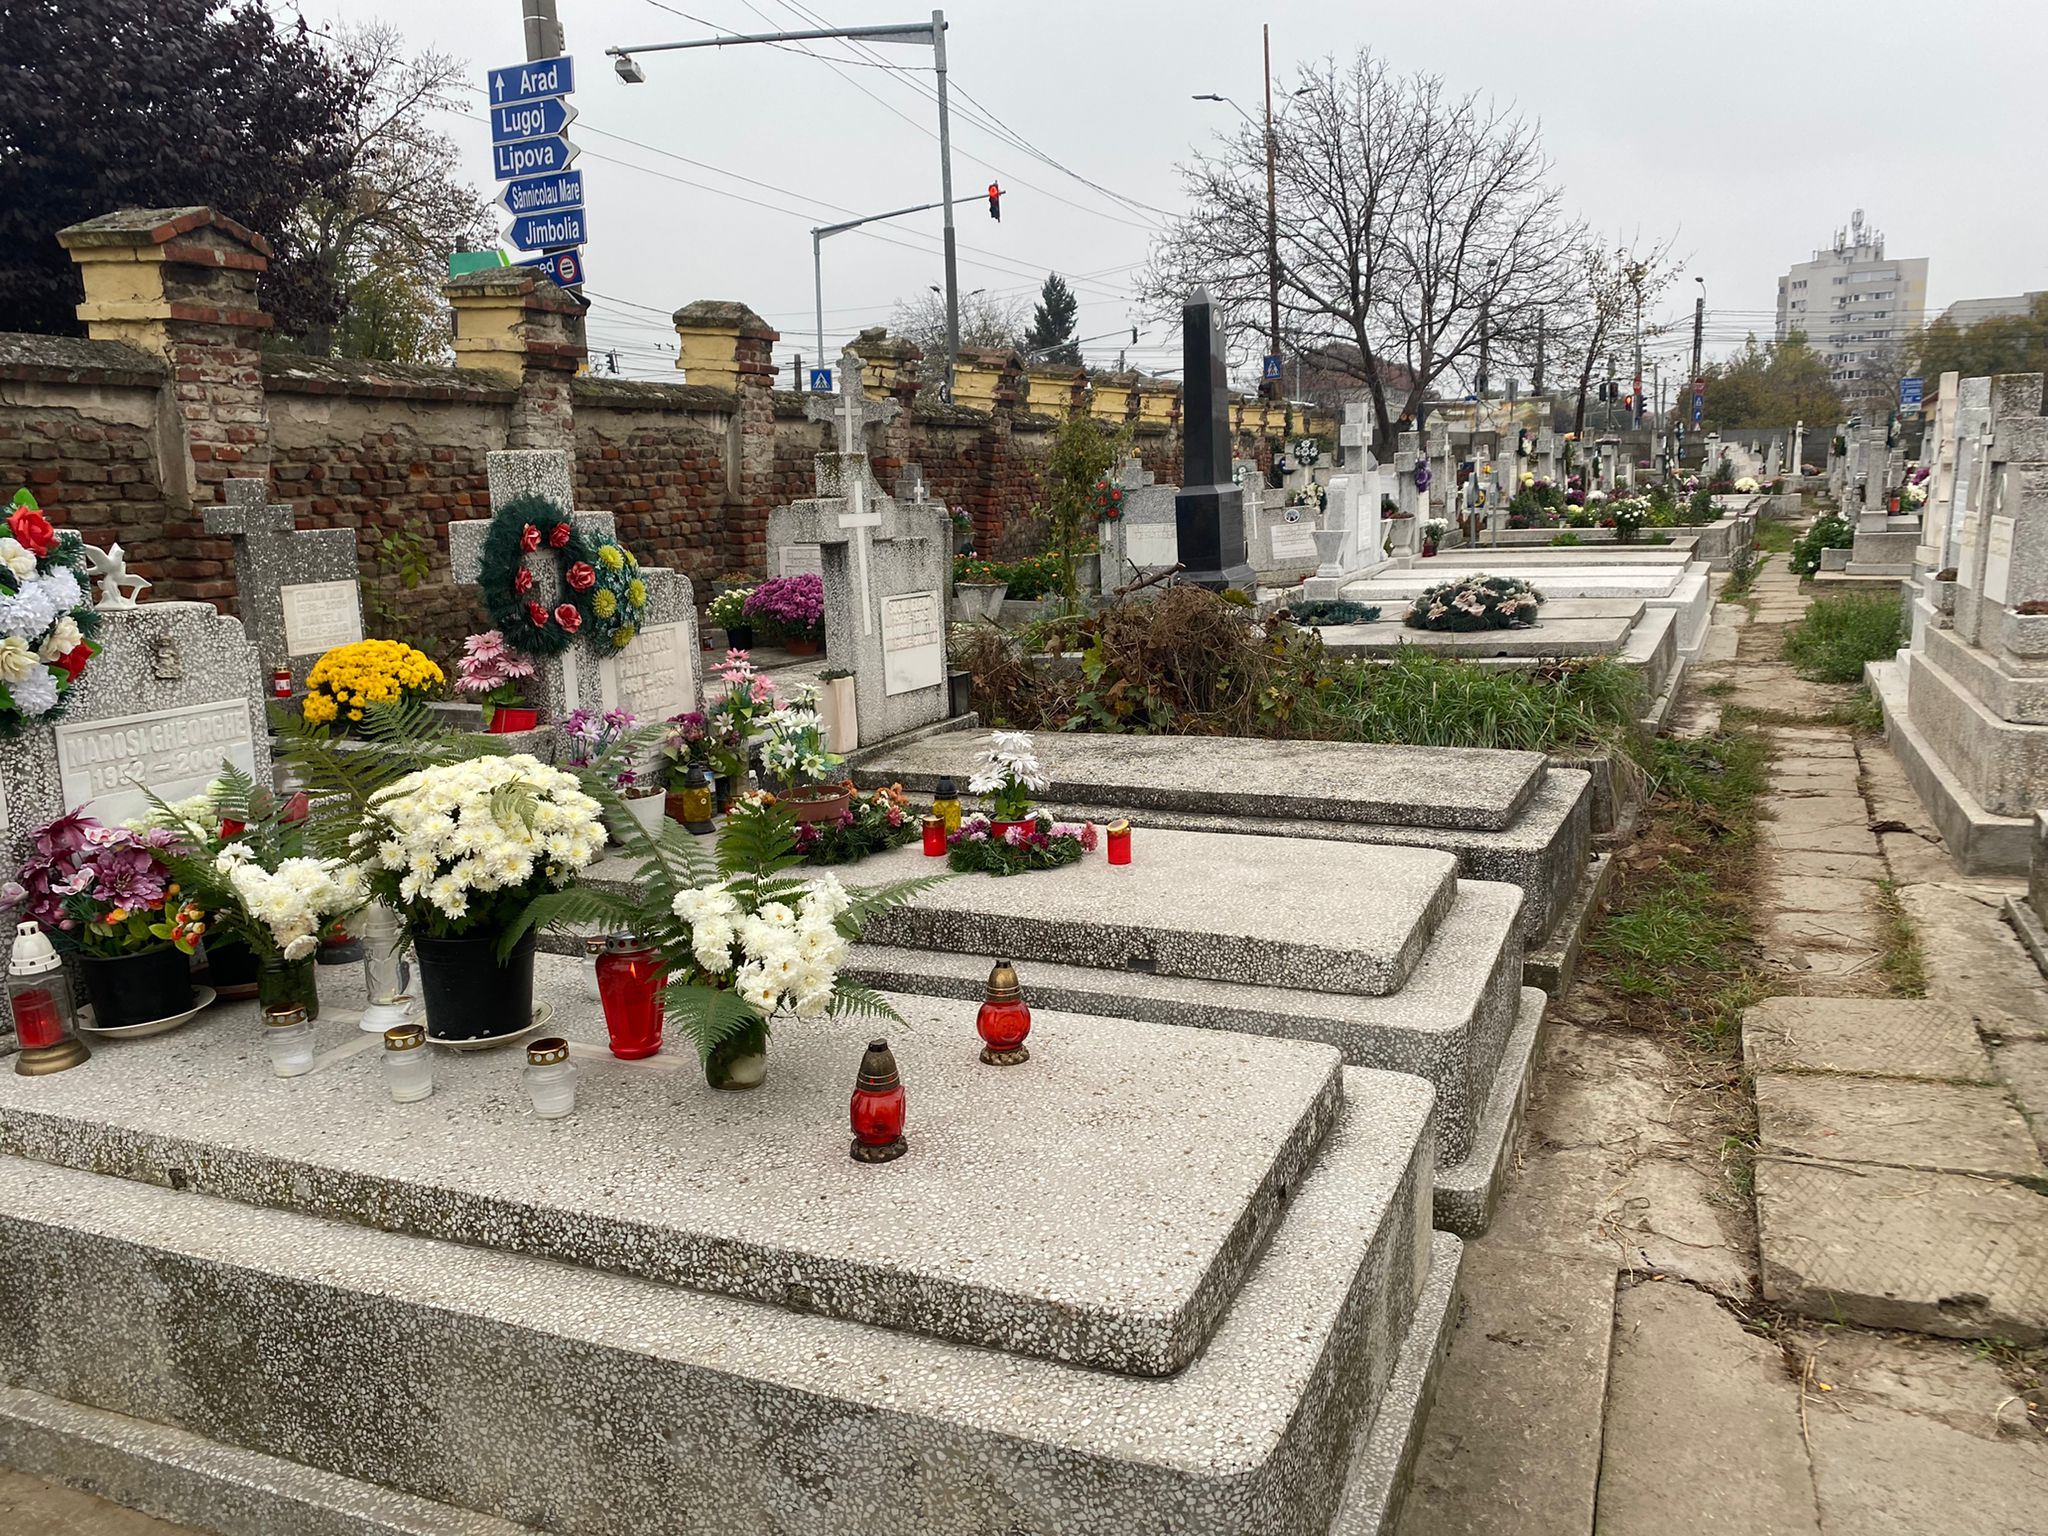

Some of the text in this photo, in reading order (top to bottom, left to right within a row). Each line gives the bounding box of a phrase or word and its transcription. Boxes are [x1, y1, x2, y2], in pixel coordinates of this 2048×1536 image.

[520, 65, 558, 94] Arad
[502, 102, 545, 135] Lugoj
[499, 145, 554, 174] Lipova
[558, 179, 580, 202] Mare
[526, 216, 580, 245] Jimbolia
[150, 712, 246, 750] GHEORGHE
[92, 760, 146, 790] 1952
[176, 745, 227, 773] 2008
